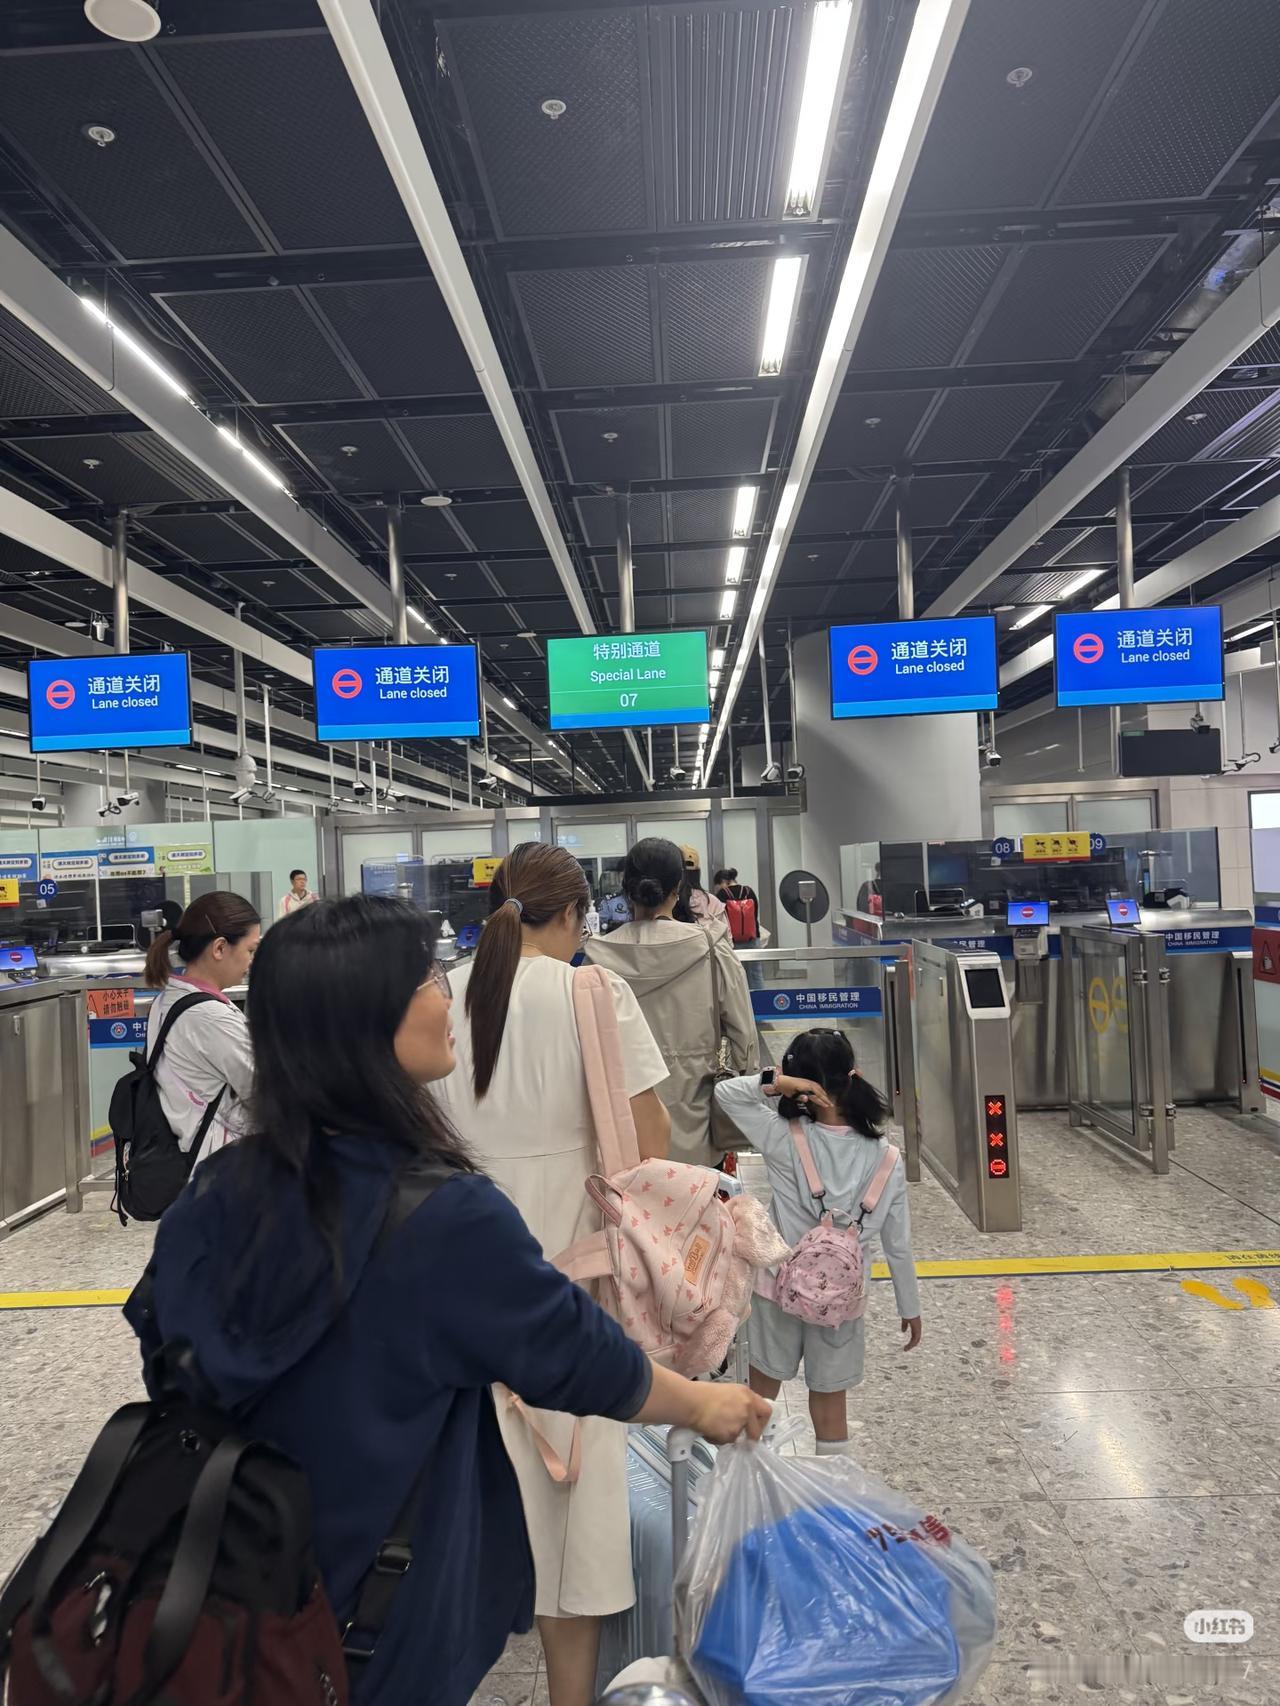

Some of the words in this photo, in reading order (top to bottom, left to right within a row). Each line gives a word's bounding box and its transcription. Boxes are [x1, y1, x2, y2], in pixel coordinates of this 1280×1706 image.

[1117, 627, 1193, 650] 通道关闭
[593, 640, 661, 661] 特别通道
[891, 638, 967, 662] 通道关闭
[1121, 652, 1150, 664] Lane
[1152, 649, 1190, 662] closed
[895, 664, 924, 675] Lane
[926, 660, 965, 673] closed
[375, 664, 450, 688] 通道关闭
[590, 668, 634, 685] Special
[636, 668, 666, 680] Lane
[87, 674, 160, 695] 通道关闭
[379, 688, 407, 700] Lane
[410, 686, 447, 699] closed
[619, 693, 638, 708] 07
[92, 697, 120, 709] Lane
[121, 695, 158, 708] closed
[995, 842, 1010, 854] 08
[39, 883, 55, 895] 05
[1165, 931, 1220, 941] 中国移民管理
[795, 990, 860, 1004] 中国移民管理
